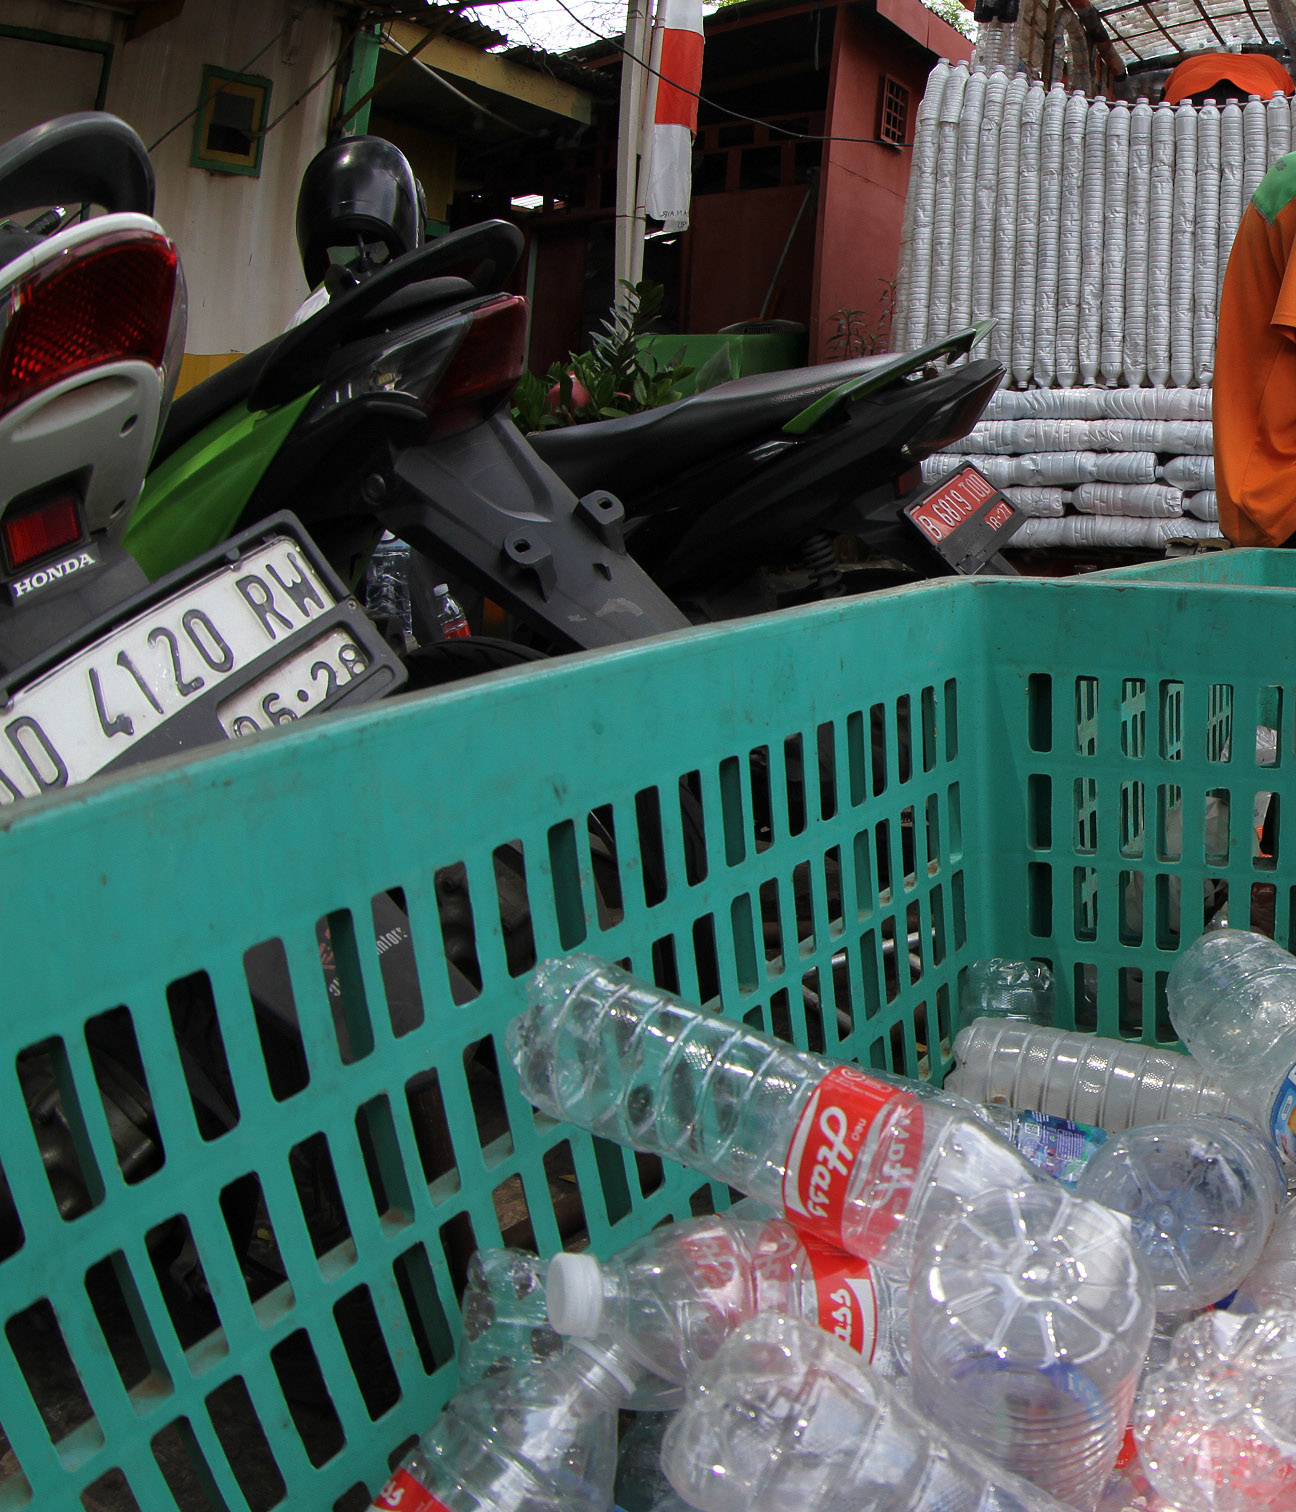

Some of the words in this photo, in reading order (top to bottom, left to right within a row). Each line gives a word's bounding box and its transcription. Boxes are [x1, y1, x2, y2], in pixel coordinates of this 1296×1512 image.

[918, 515, 943, 541] B
[931, 489, 973, 527] 6819
[13, 553, 96, 598] HONDA
[88, 608, 235, 738] 4120
[235, 551, 326, 641] RW
[851, 1118, 867, 1142] neo
[807, 1105, 854, 1219] Hass
[830, 1288, 852, 1347] ass
